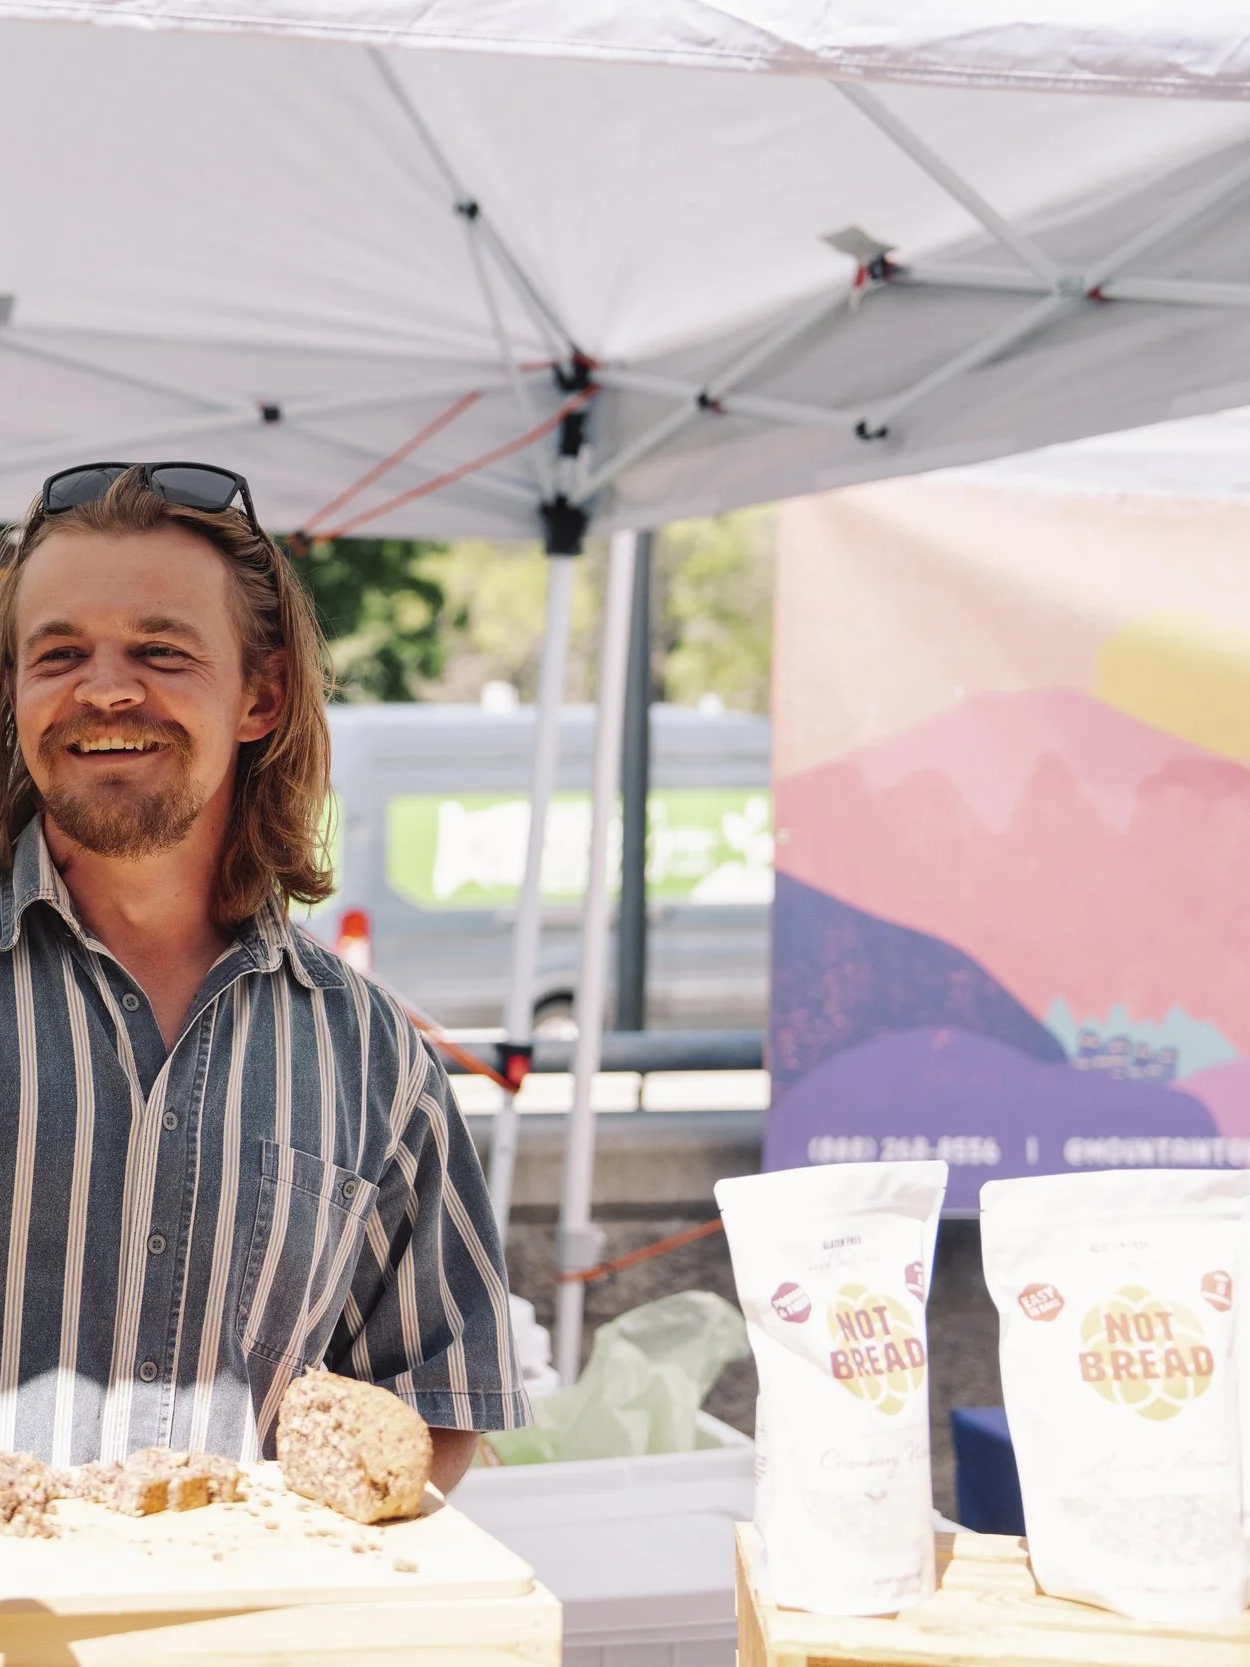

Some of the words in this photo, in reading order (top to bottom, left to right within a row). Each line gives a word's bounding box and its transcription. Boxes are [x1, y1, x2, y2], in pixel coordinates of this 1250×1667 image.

[1020, 1286, 1054, 1309] EASY
[835, 1305, 891, 1341] NOT
[1104, 1311, 1174, 1343] NOT
[830, 1337, 925, 1380] BREAD
[1079, 1345, 1215, 1382] BREAD
